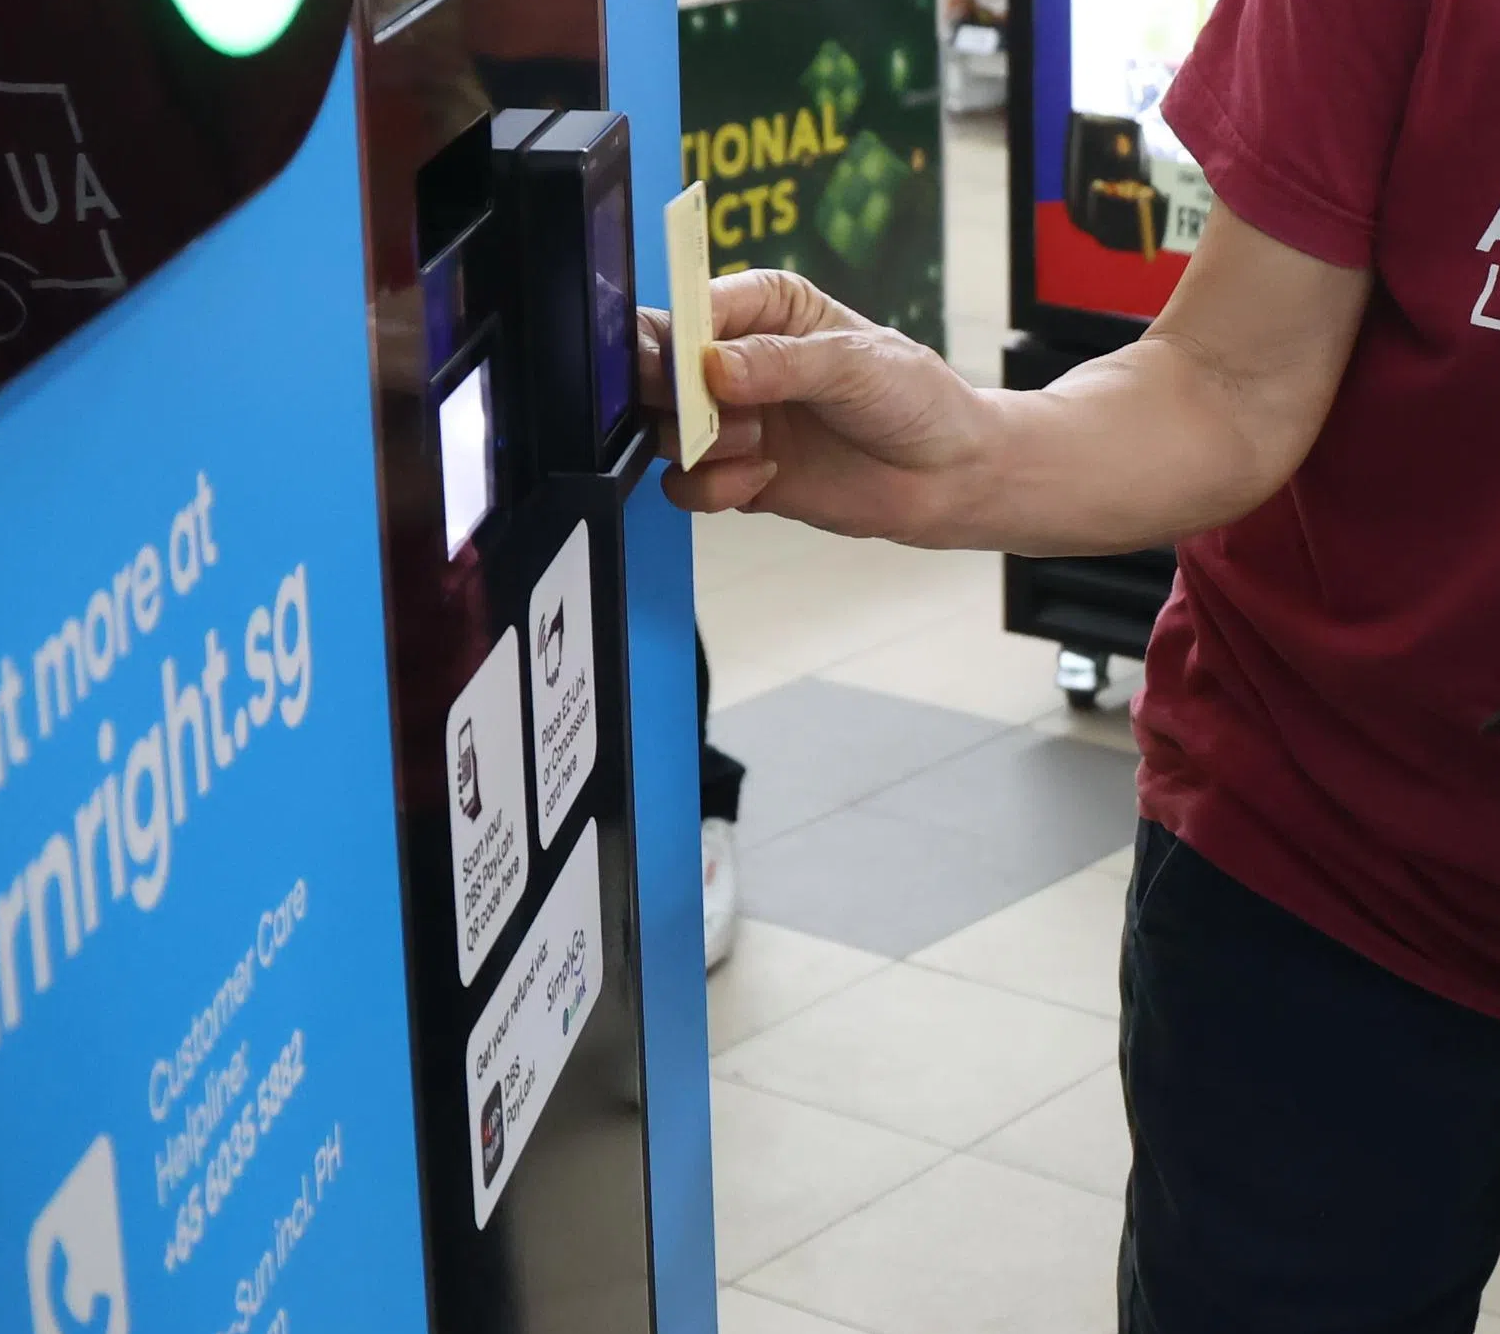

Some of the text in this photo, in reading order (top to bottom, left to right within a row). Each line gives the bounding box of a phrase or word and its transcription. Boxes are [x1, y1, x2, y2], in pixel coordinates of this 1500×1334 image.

[32, 543, 162, 740] more
[169, 470, 217, 595] at
[541, 668, 586, 753] Place EZ-Link
[551, 699, 590, 774] Concession
[545, 754, 578, 818] card here
[462, 808, 503, 883] Scan your
[464, 882, 482, 919] DBS
[466, 855, 520, 952] QR code here
[148, 876, 307, 1122] Customer Care
[476, 1048, 491, 1080] Get
[491, 1012, 510, 1058] your
[509, 960, 535, 1020] refund
[504, 1055, 520, 1098] DBS
[155, 1039, 249, 1208] Helpline:
[314, 1119, 343, 1201] PH
[164, 1182, 205, 1273] +65
